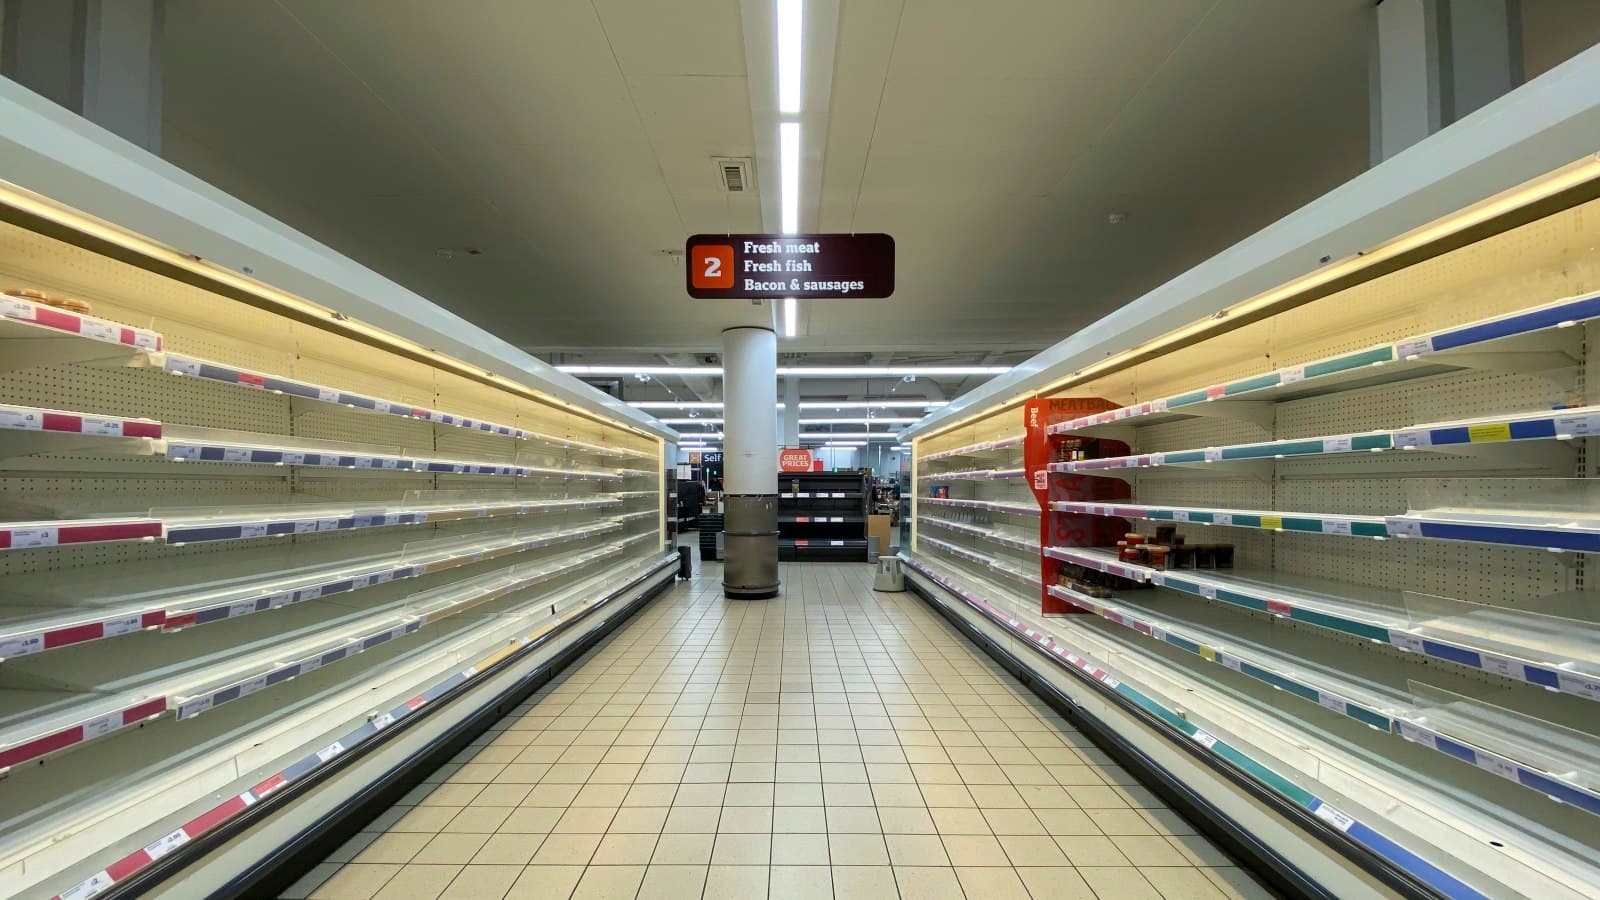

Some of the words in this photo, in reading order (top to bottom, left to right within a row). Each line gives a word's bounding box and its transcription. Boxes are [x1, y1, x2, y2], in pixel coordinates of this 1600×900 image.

[744, 242, 782, 253] Fresh
[785, 242, 820, 253] meat
[704, 257, 721, 277] 2
[744, 260, 782, 272] Fresh
[785, 260, 812, 272] fish
[744, 279, 787, 291] Bacon
[789, 279, 800, 290] &
[803, 280, 864, 293] sausages
[1030, 407, 1039, 428] Beef
[704, 454, 722, 462] Self
